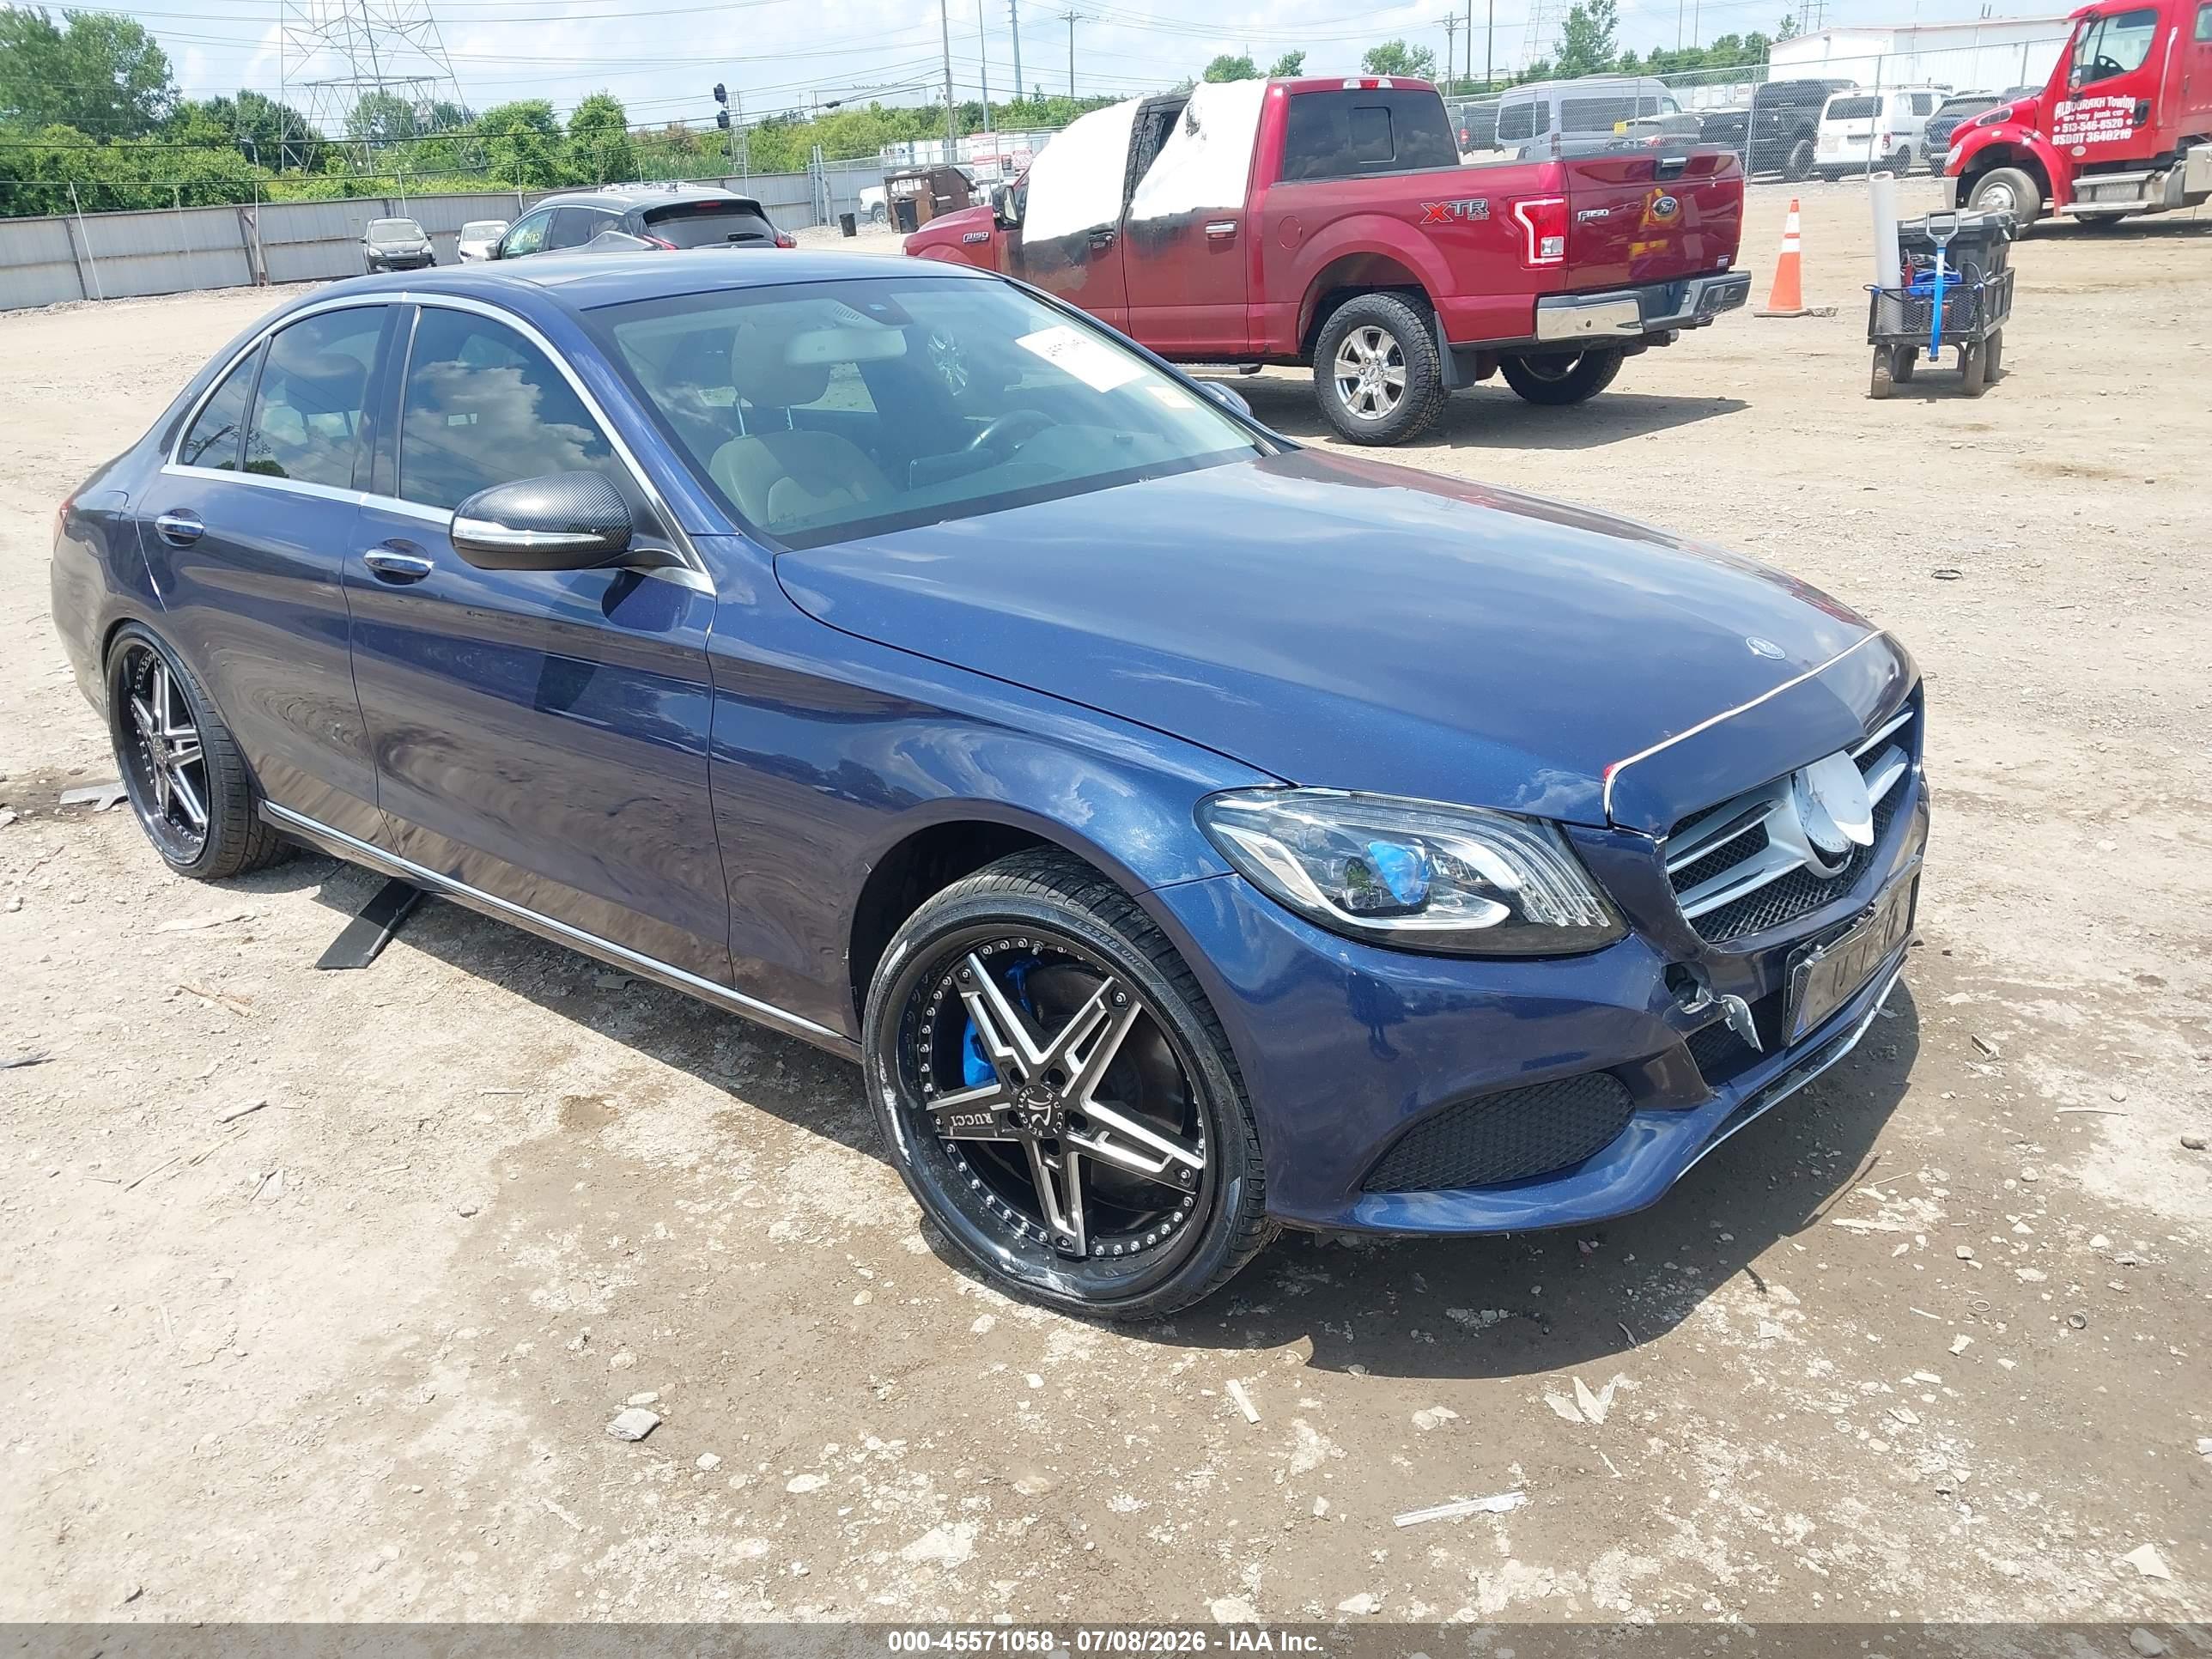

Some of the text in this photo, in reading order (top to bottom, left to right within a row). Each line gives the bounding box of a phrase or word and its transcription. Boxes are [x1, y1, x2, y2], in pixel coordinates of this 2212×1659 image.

[2107, 94, 2136, 113] Towing
[2052, 132, 2085, 145] USDOT
[1420, 198, 1490, 224] XTR
[1121, 950, 1145, 968] UHP
[950, 1113, 994, 1127] RUCCI
